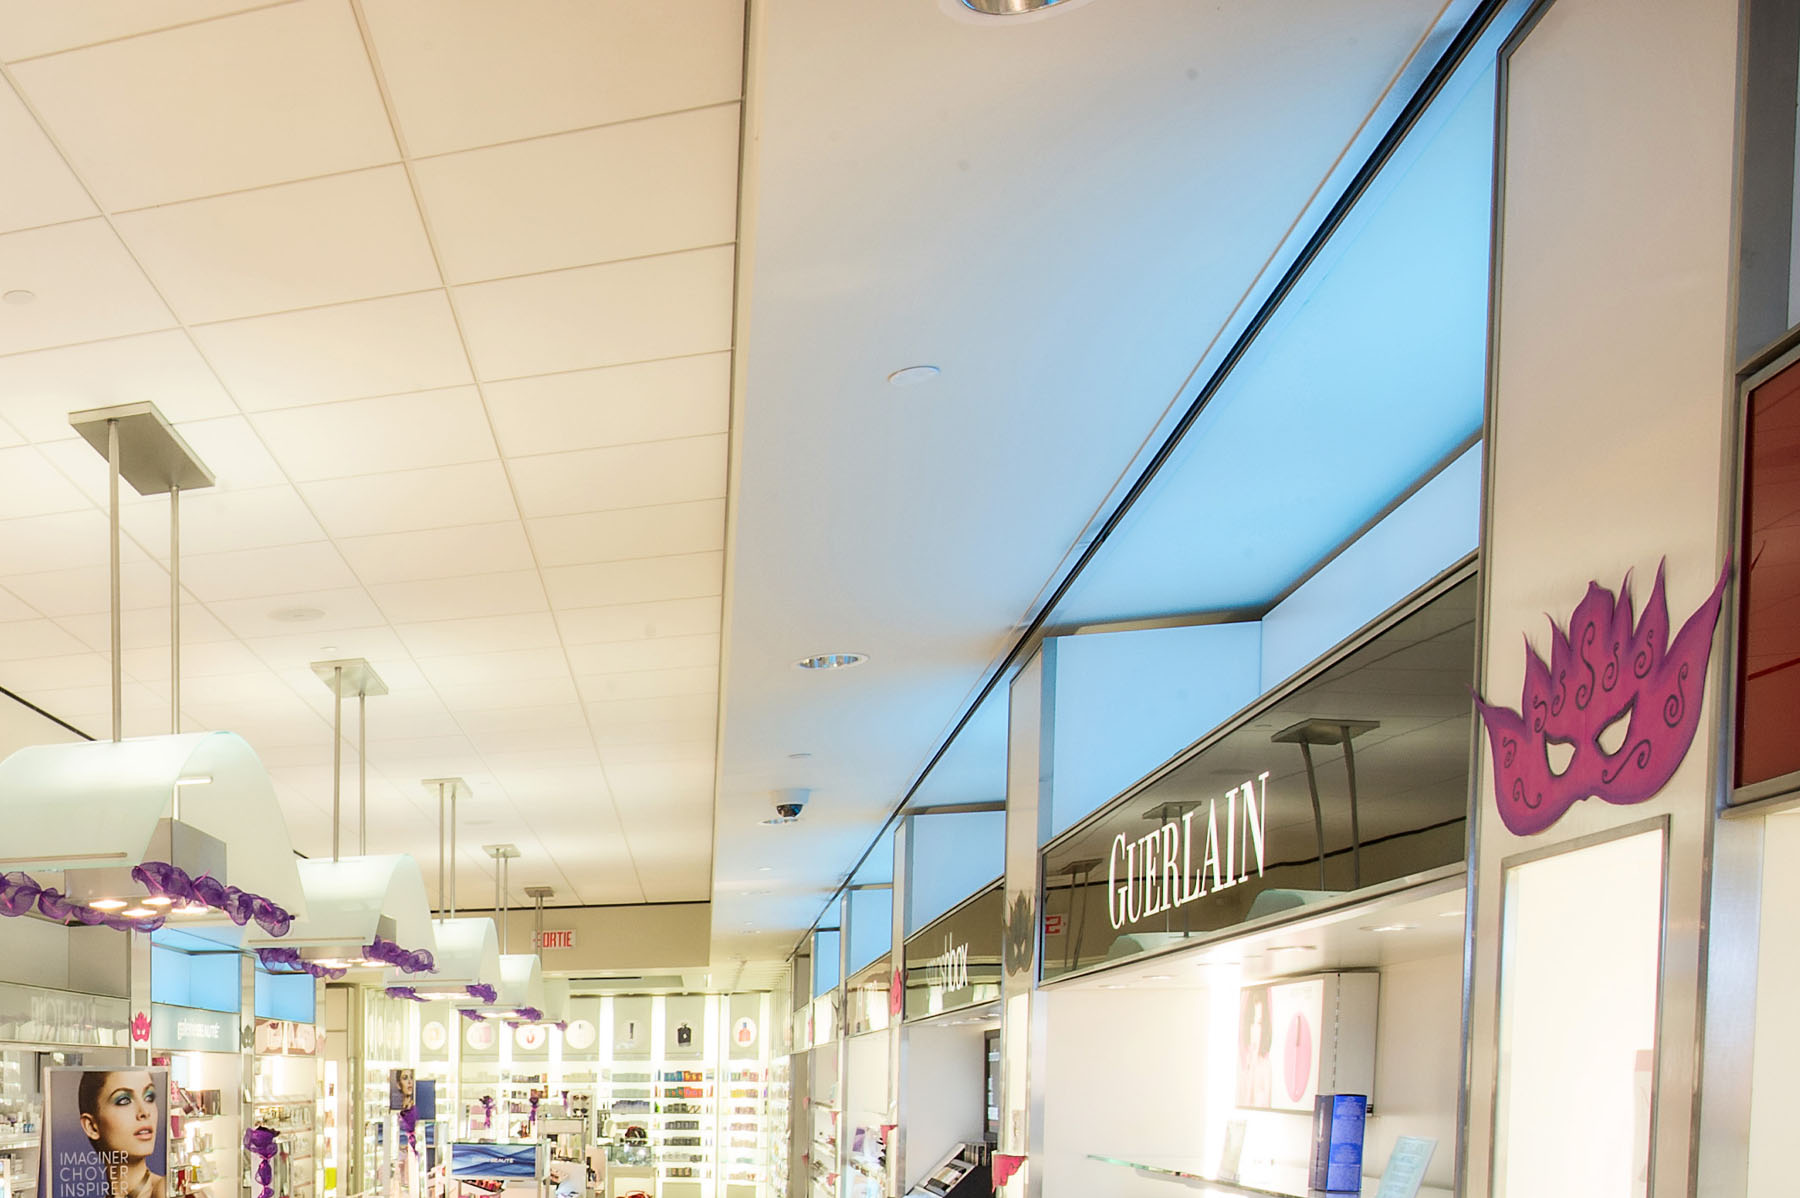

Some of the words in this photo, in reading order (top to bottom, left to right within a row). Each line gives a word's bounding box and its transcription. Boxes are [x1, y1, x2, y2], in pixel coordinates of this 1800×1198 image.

[1108, 771, 1270, 930] GUERLAIN
[60, 1150, 129, 1165] IMAGINER
[60, 1166, 129, 1182] CHOYER
[60, 1181, 129, 1198] INSPIRER
